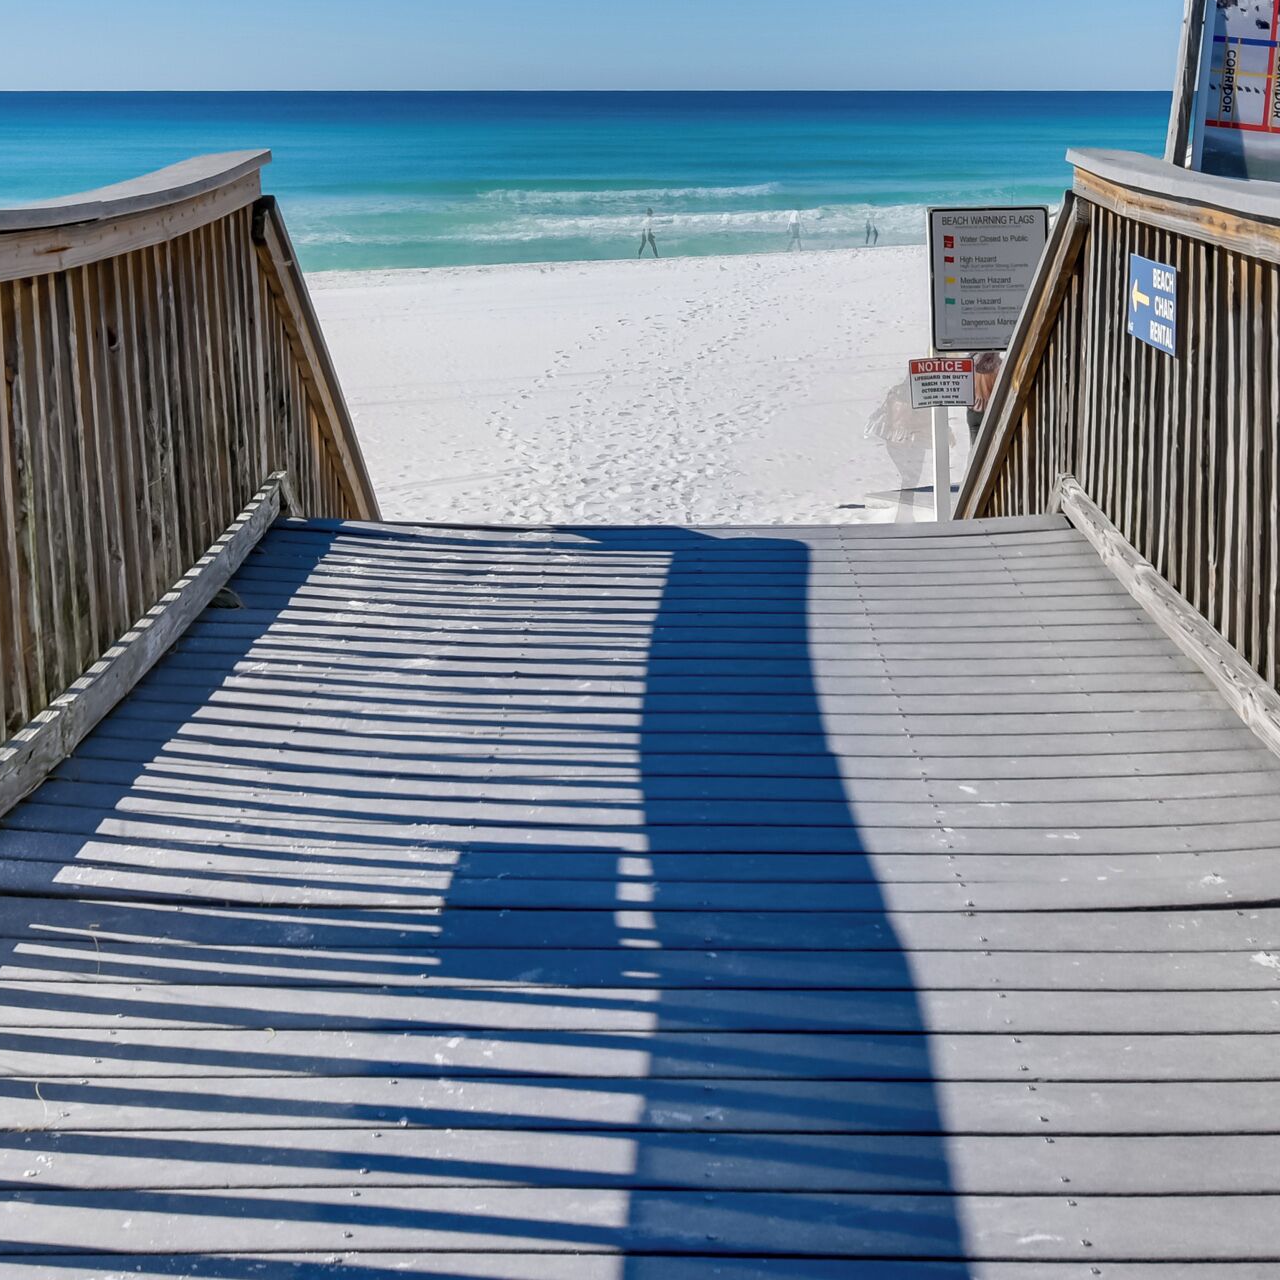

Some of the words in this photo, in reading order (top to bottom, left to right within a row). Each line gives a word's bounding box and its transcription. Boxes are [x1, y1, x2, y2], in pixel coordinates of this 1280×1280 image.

[1222, 50, 1236, 113] CORRIDOR
[942, 216, 968, 225] BEACH
[971, 216, 1007, 225] WARNING
[1009, 215, 1034, 224] FLAGS
[1152, 268, 1174, 294] BEACH
[1154, 295, 1174, 322] CHAIR
[961, 319, 995, 327] Dangerous
[1150, 320, 1173, 349] RENTAL
[918, 361, 963, 372] NOTICE
